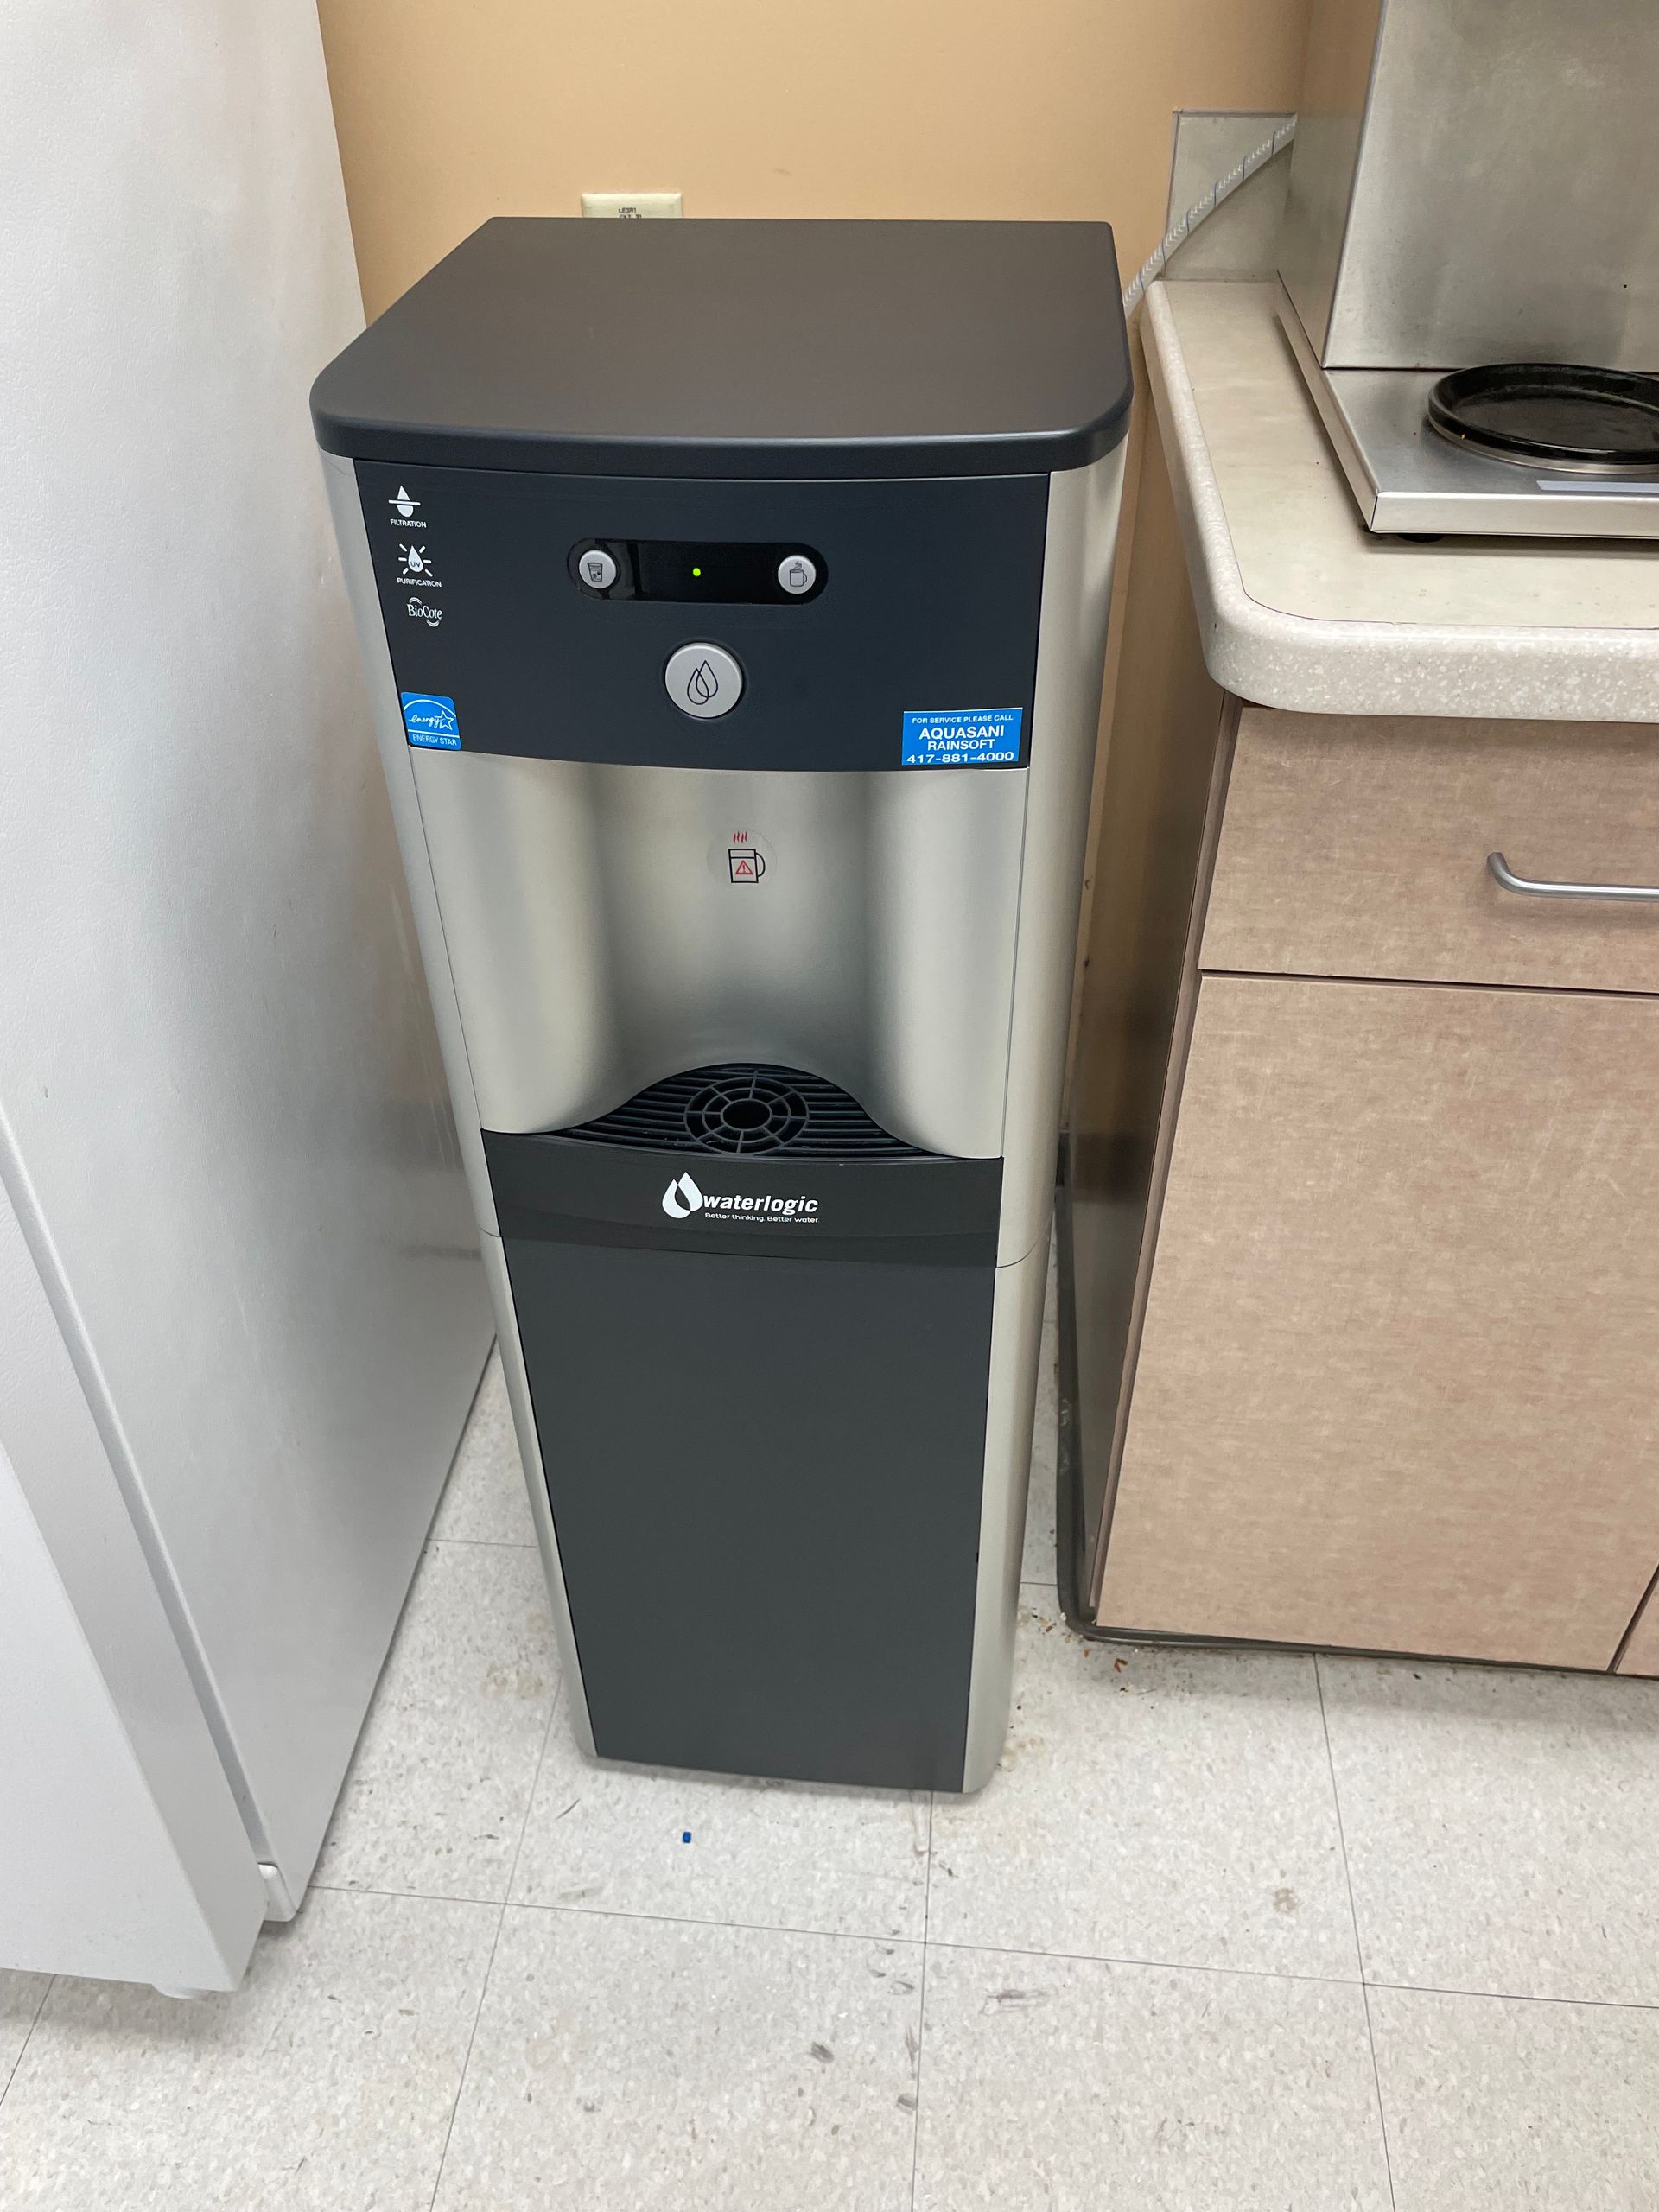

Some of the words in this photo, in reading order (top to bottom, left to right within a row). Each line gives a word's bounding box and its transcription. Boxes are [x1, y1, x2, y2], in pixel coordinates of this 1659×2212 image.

[390, 518, 427, 528] FILTRATION
[397, 577, 442, 588] PURIFICATION
[407, 603, 442, 620] BioCote
[918, 724, 1005, 740] AQUASANI
[412, 734, 439, 743] ENERGY
[439, 737, 457, 746] STAR
[927, 739, 996, 751] RAINSOFT
[906, 751, 1014, 764] 417-881-4000
[702, 1195, 818, 1216] waterlogic
